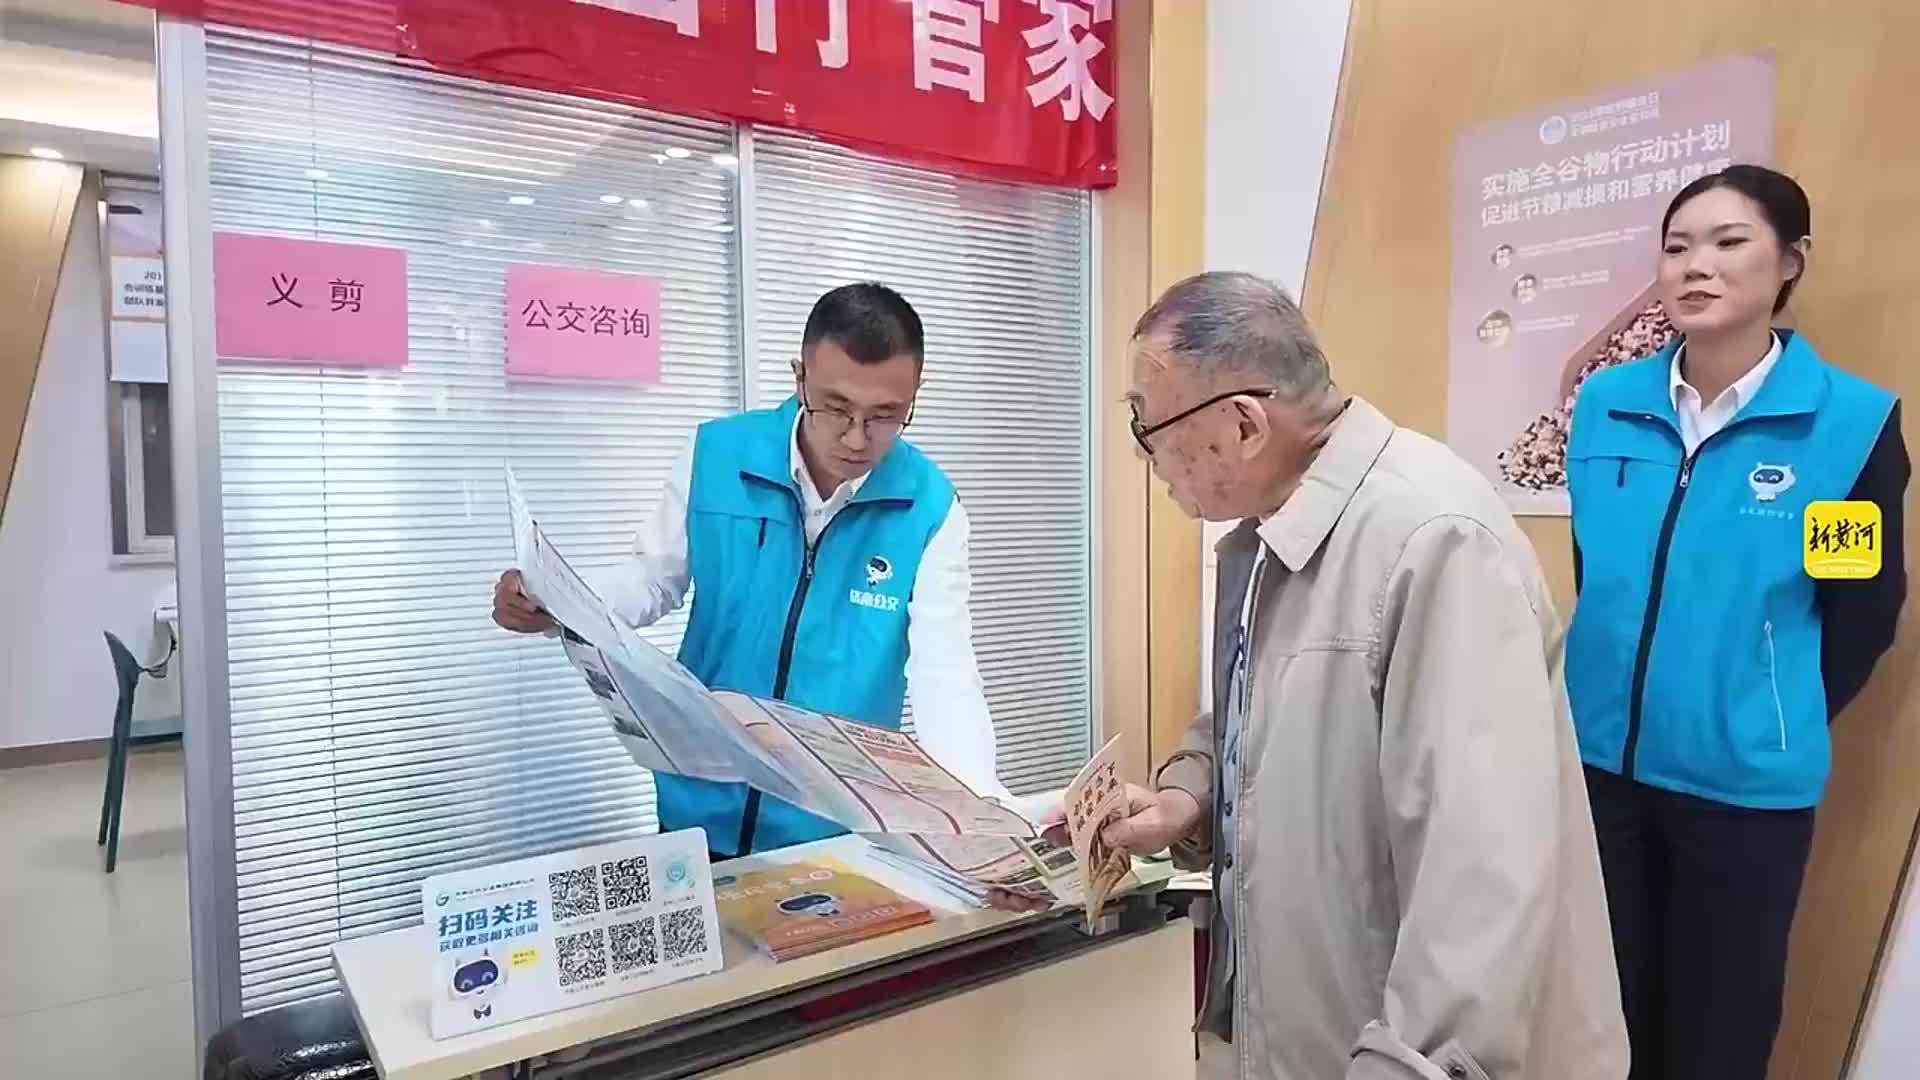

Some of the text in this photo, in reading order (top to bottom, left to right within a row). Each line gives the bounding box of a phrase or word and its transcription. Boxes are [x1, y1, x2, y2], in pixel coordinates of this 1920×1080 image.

[1481, 120, 1731, 201] 实施全谷物行动计划
[521, 299, 651, 338] 公交咨询
[439, 899, 537, 936] 扫码关注
